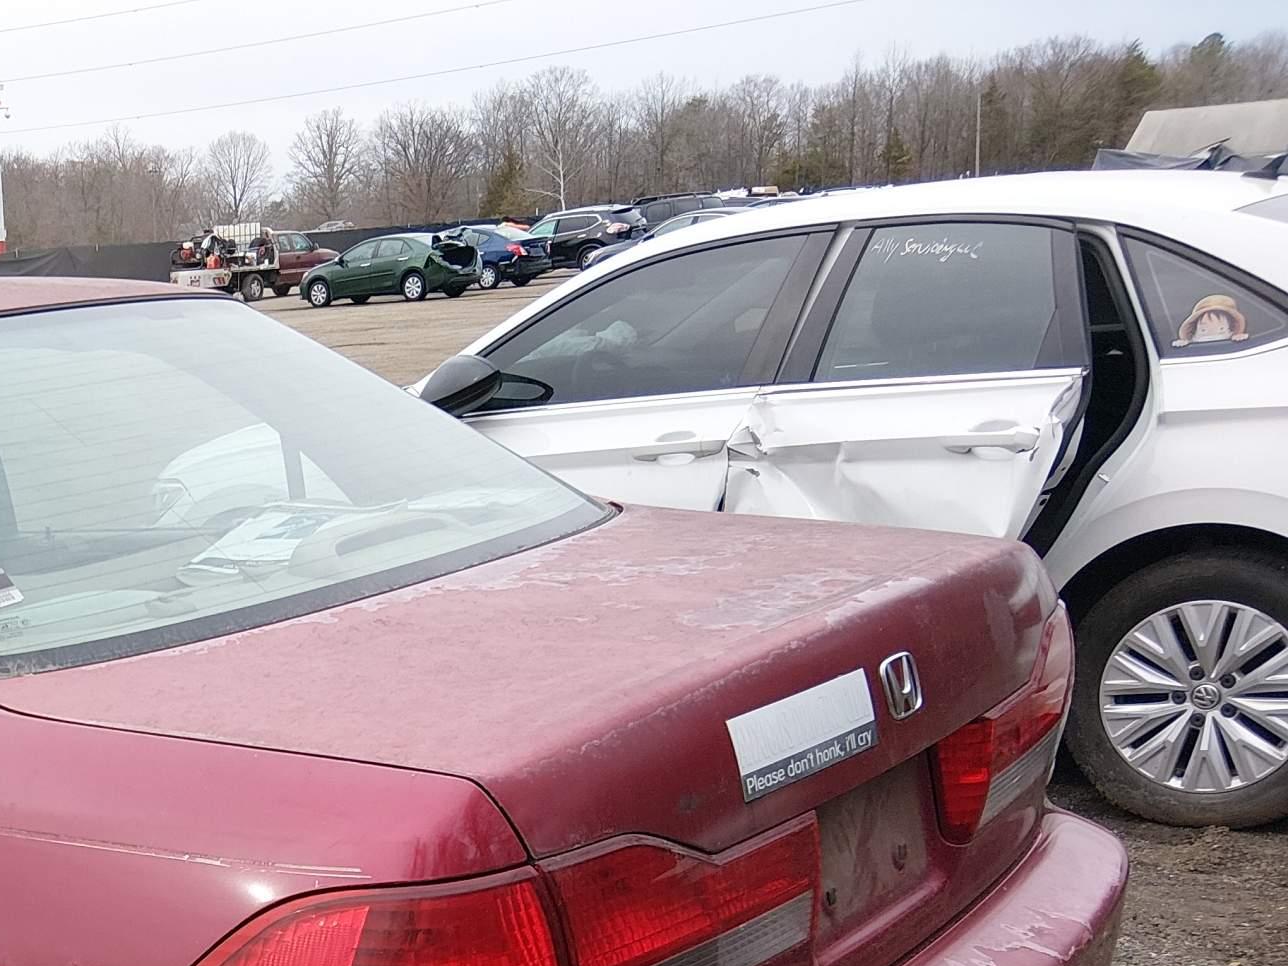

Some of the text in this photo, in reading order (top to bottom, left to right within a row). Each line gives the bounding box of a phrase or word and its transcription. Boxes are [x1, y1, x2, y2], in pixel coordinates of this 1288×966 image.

[745, 768, 786, 795] Please
[787, 754, 814, 778] don't
[815, 742, 846, 766] honk,
[857, 729, 873, 747] cry
